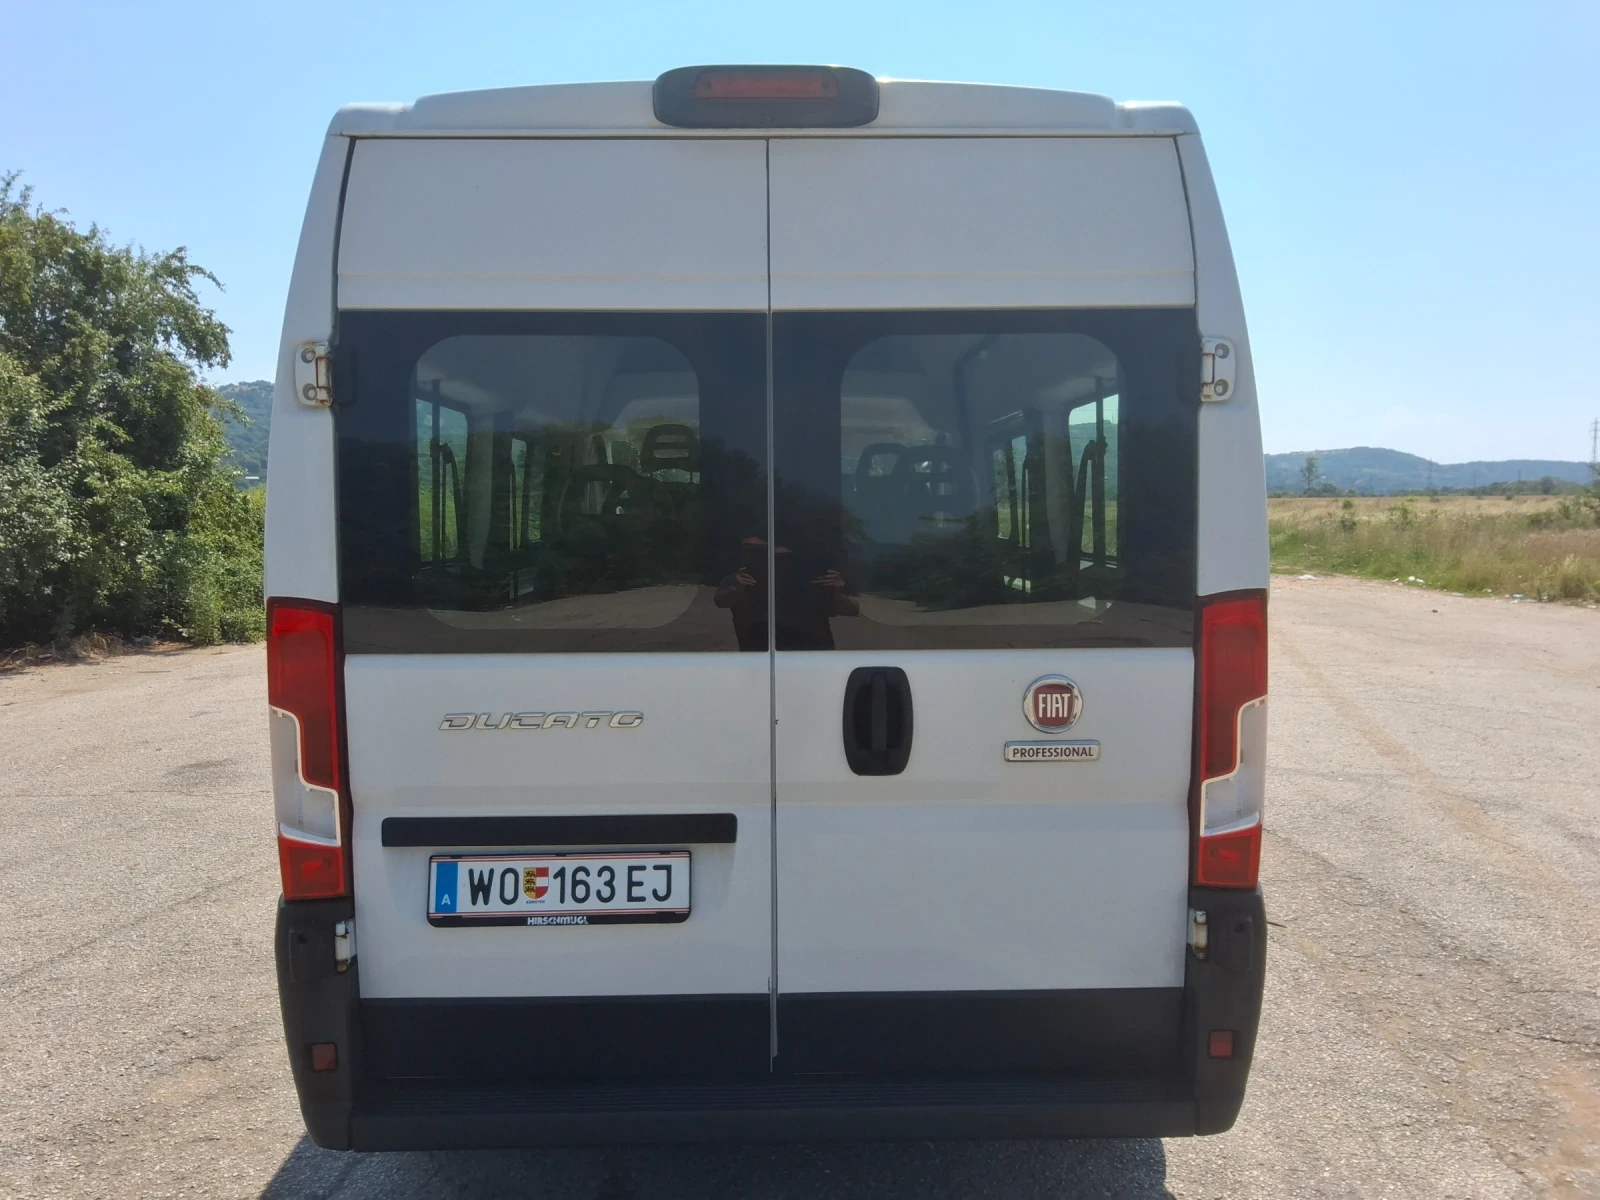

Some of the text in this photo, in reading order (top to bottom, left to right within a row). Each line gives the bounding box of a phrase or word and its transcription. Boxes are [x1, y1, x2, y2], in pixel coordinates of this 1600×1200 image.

[1038, 693, 1071, 718] FIAT
[439, 711, 644, 730] DUCATO
[1012, 747, 1094, 758] PROFESSIONAL
[441, 864, 673, 906] A WO 163 EJ
